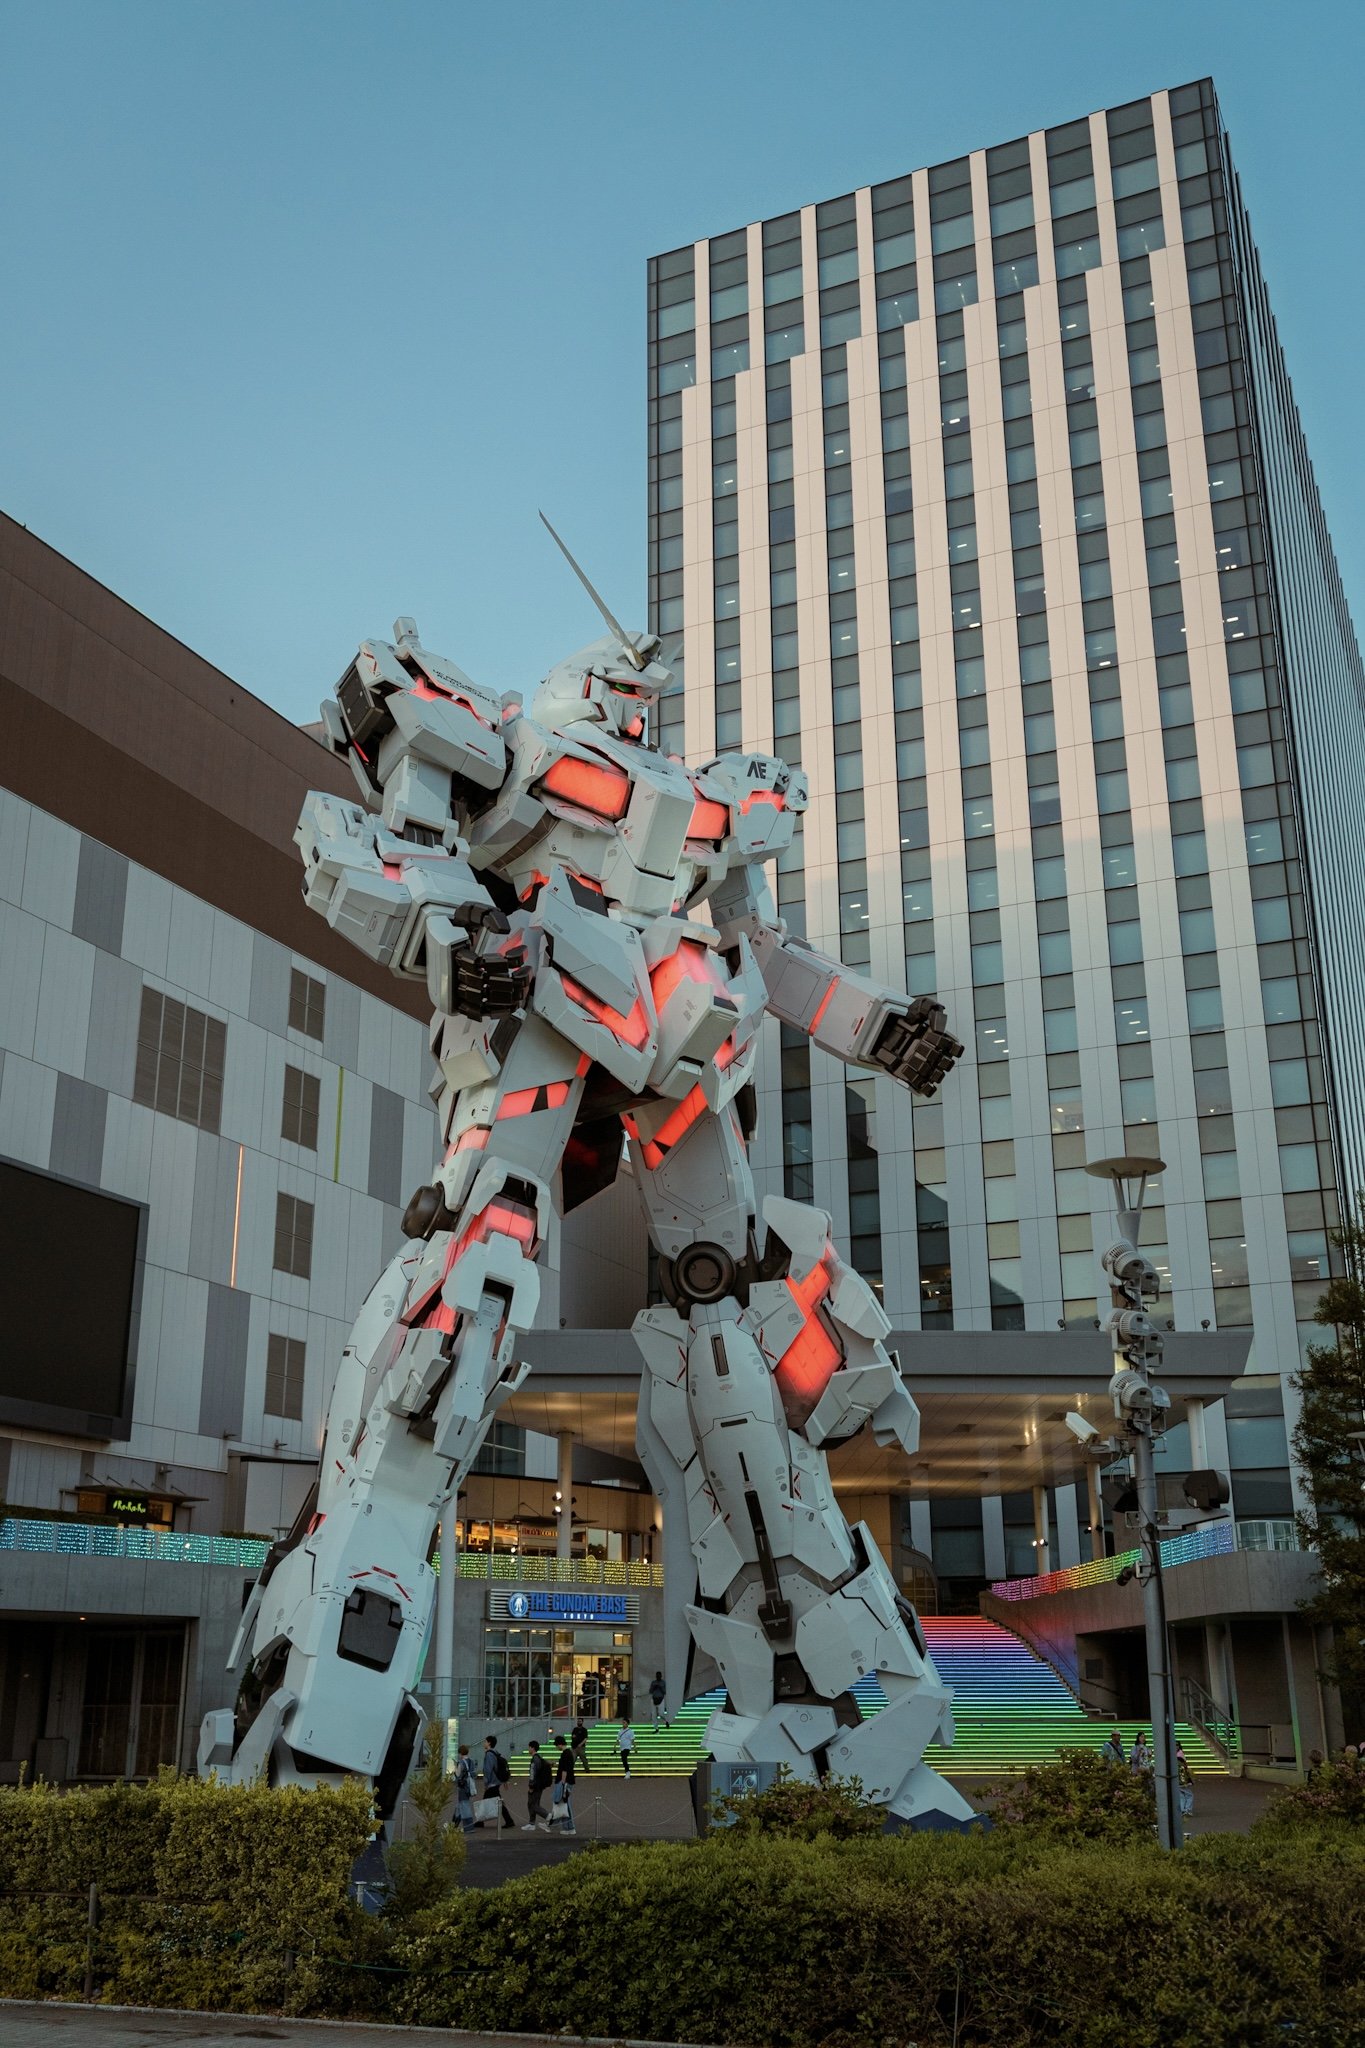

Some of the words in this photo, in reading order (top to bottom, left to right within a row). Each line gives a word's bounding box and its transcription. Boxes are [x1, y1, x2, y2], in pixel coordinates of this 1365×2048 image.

[530, 1593, 549, 1611] THE
[552, 1594, 598, 1612] GUNDAM
[601, 1596, 626, 1613] BASE
[563, 1612, 594, 1620] TOKYO
